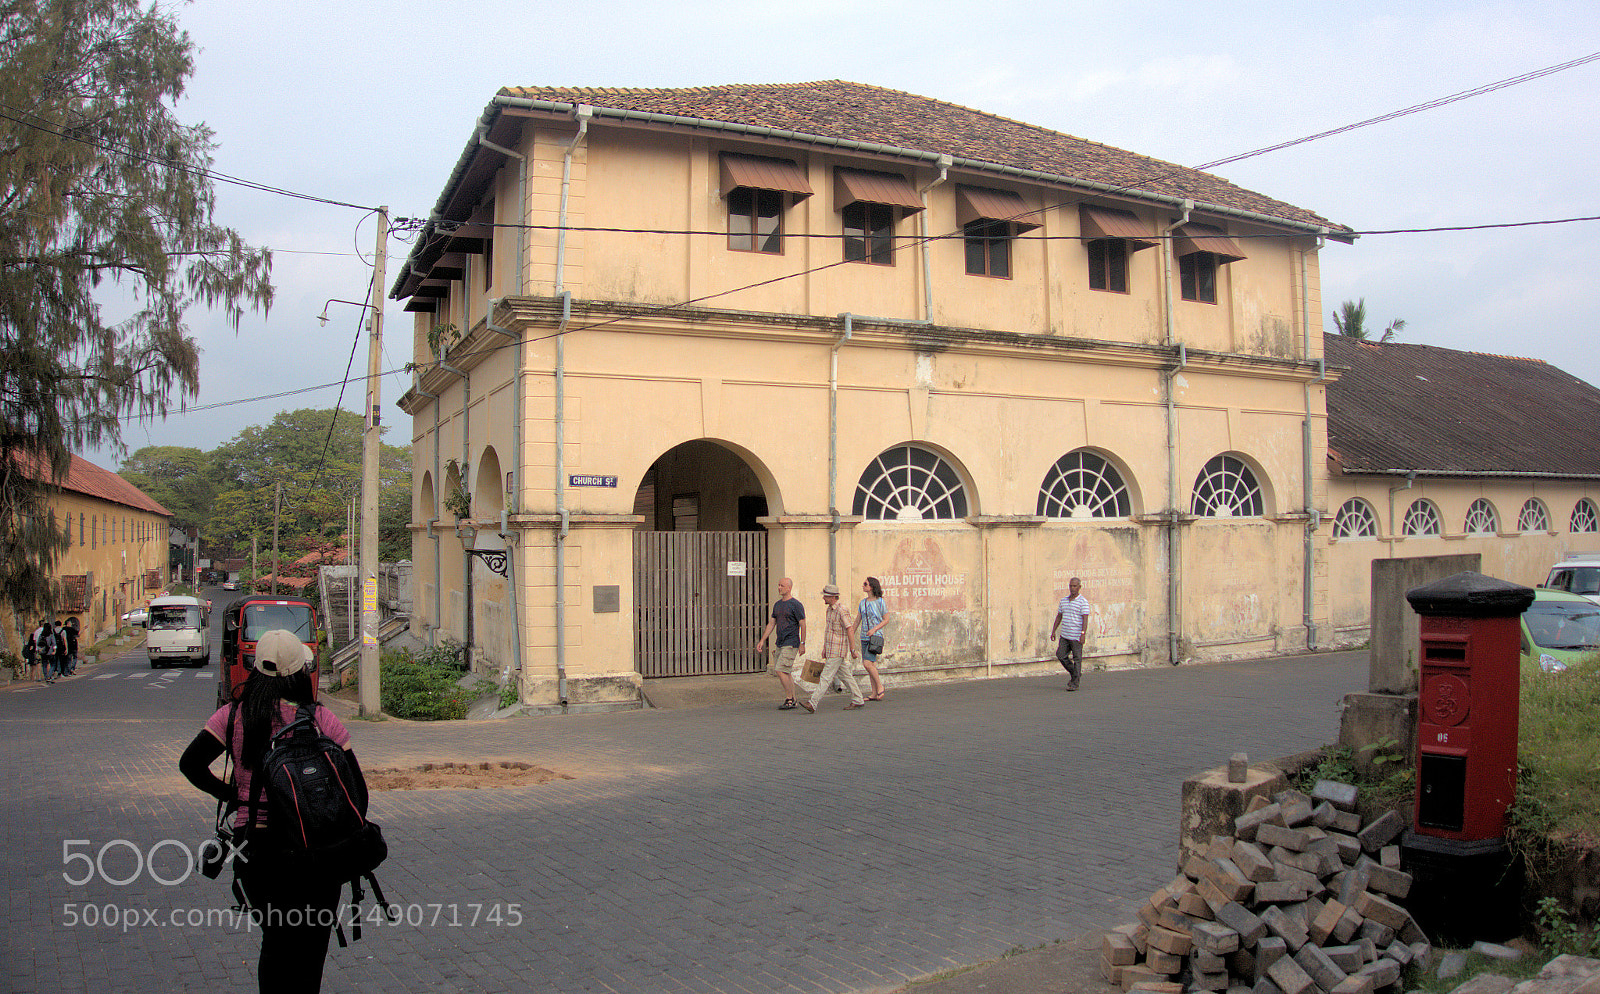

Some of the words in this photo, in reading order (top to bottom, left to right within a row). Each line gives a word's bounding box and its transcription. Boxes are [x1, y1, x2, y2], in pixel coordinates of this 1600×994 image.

[573, 477, 602, 485] CHURCH
[875, 575, 901, 586] OYAL
[903, 575, 932, 585] DUTCH
[935, 574, 964, 585] HOUSE
[881, 588, 899, 597] OTEL
[903, 588, 909, 597] &
